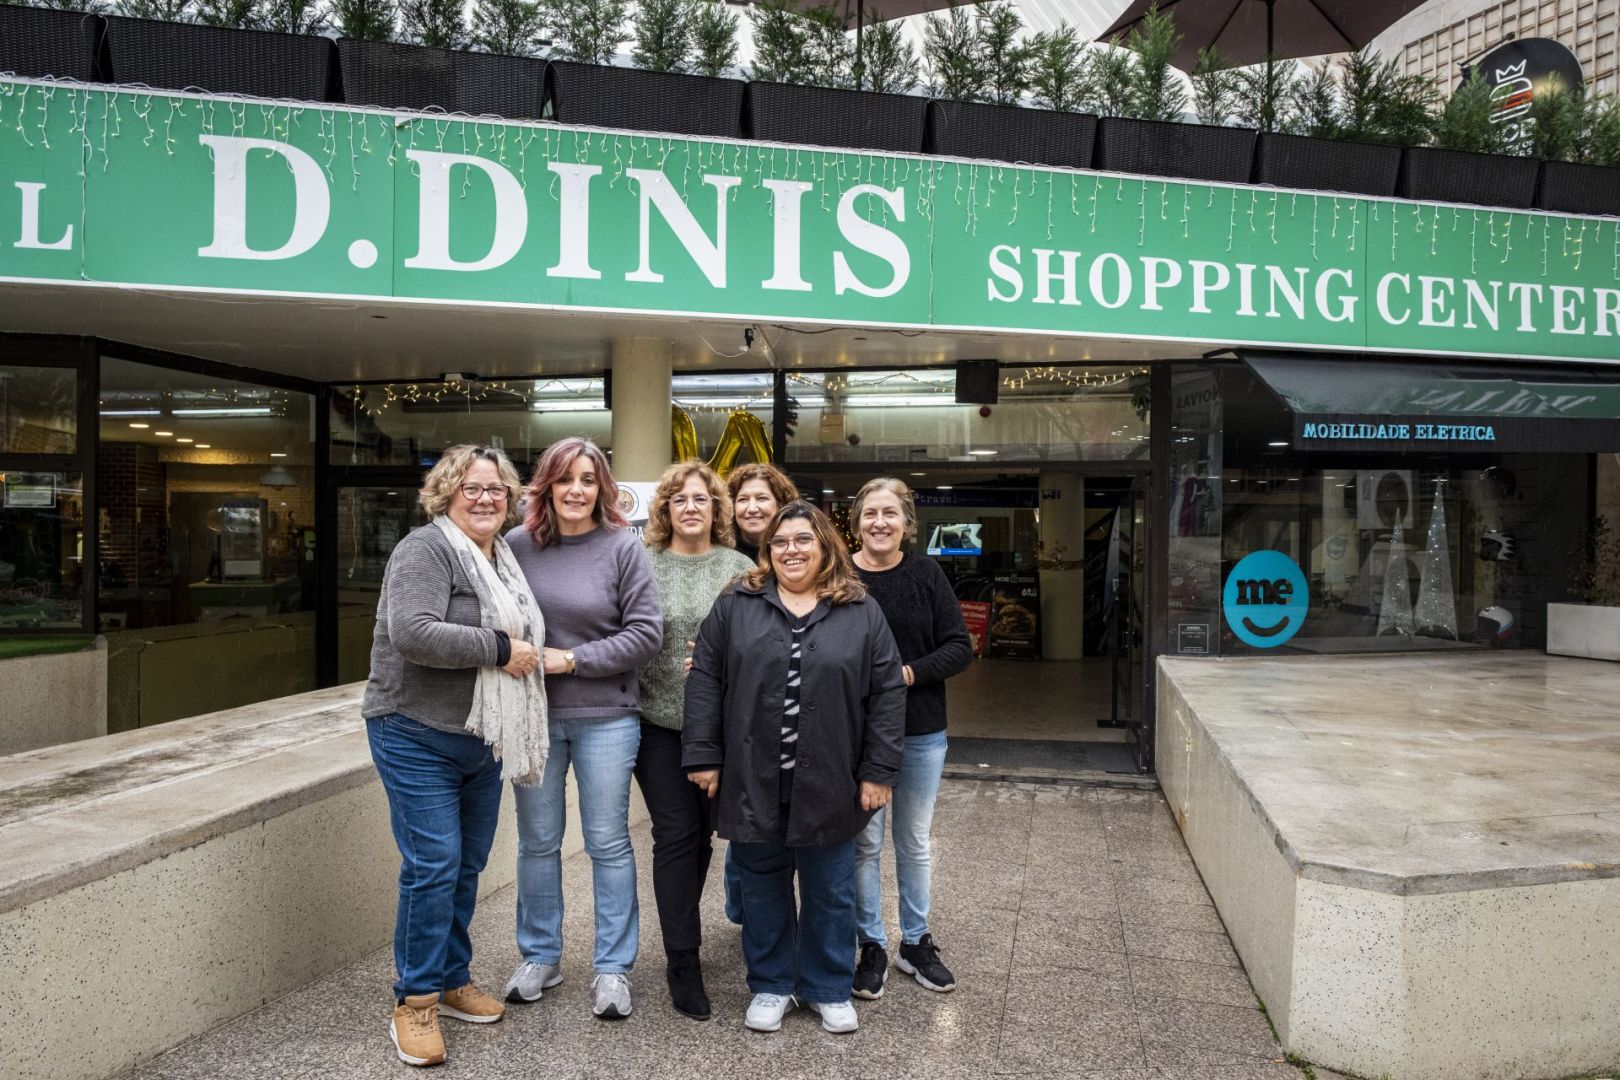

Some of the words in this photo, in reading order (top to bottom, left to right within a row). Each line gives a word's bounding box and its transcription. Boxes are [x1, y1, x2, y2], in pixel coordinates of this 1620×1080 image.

[197, 133, 911, 298] D.DINIS
[987, 244, 1359, 323] SHOPPING
[1376, 271, 1620, 336] CENTER
[1303, 423, 1409, 439] MOBILIDADE
[1414, 425, 1495, 441] ELETRICA
[1236, 578, 1294, 606] me
